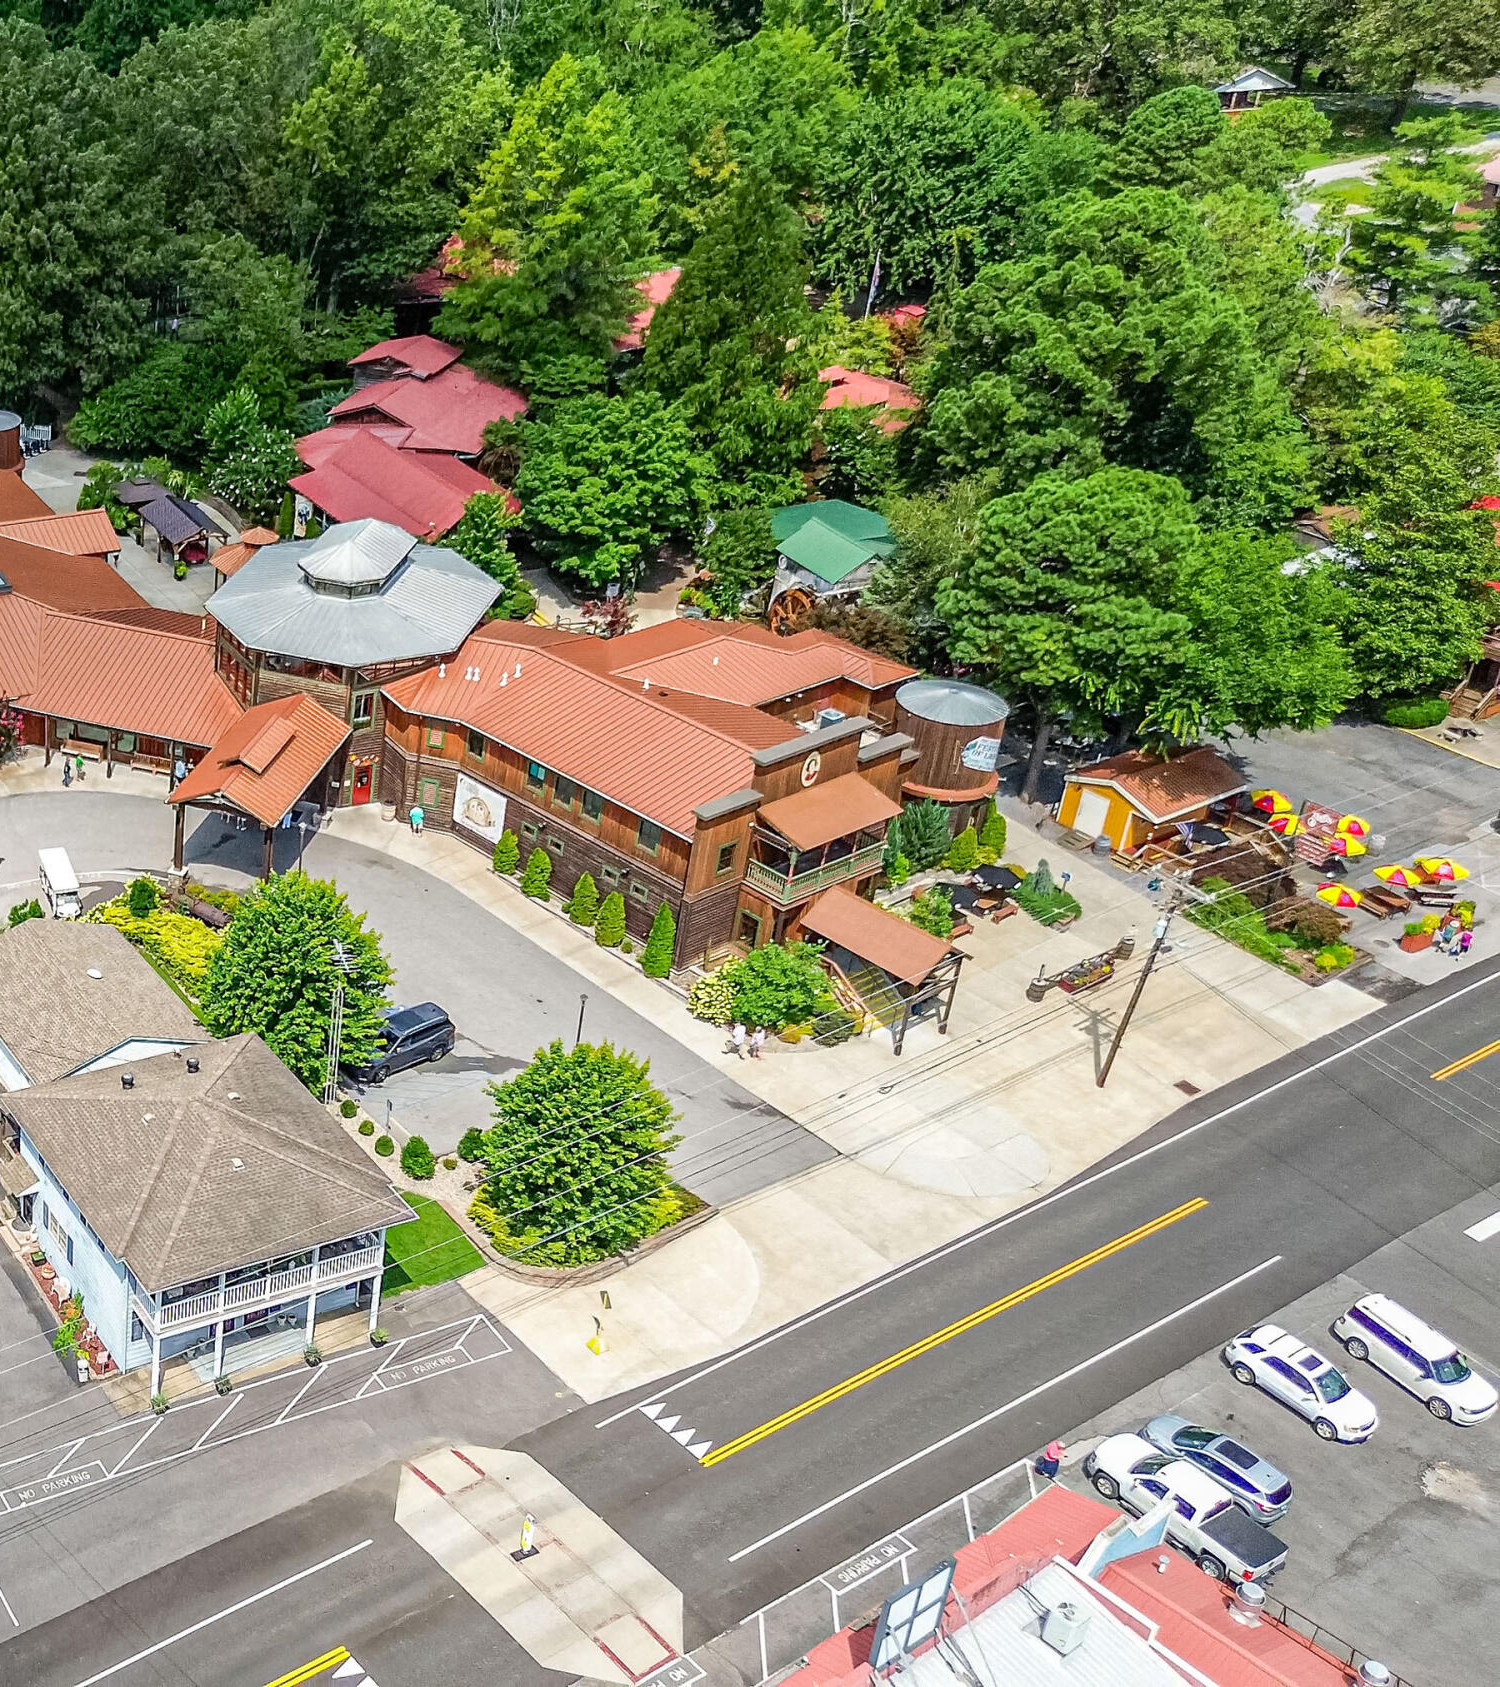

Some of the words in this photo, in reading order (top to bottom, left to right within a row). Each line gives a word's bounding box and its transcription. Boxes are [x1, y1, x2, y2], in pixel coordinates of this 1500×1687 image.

[389, 1371, 407, 1382] NO
[412, 1355, 456, 1375] PARKING
[18, 1489, 36, 1501] NO
[42, 1471, 91, 1493] PARKING
[880, 1543, 900, 1558] NO
[837, 1554, 882, 1583] PARKING
[668, 1666, 689, 1682] NO
